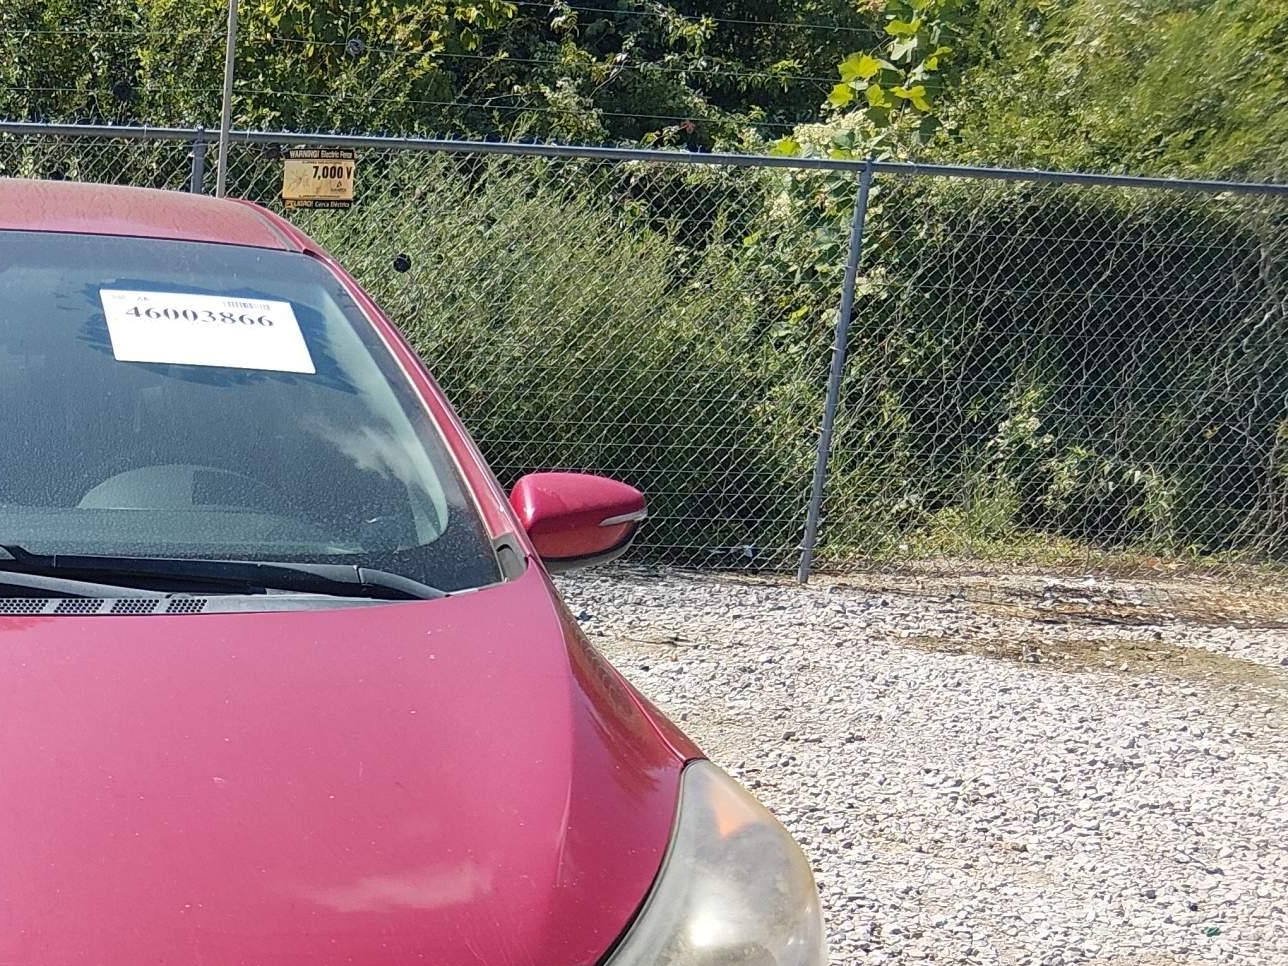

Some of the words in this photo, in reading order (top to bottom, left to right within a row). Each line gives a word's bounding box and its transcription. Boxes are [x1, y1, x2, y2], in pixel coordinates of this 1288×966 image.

[312, 166, 344, 180] 7,000
[346, 166, 353, 179] V
[125, 305, 275, 328] 46003866
